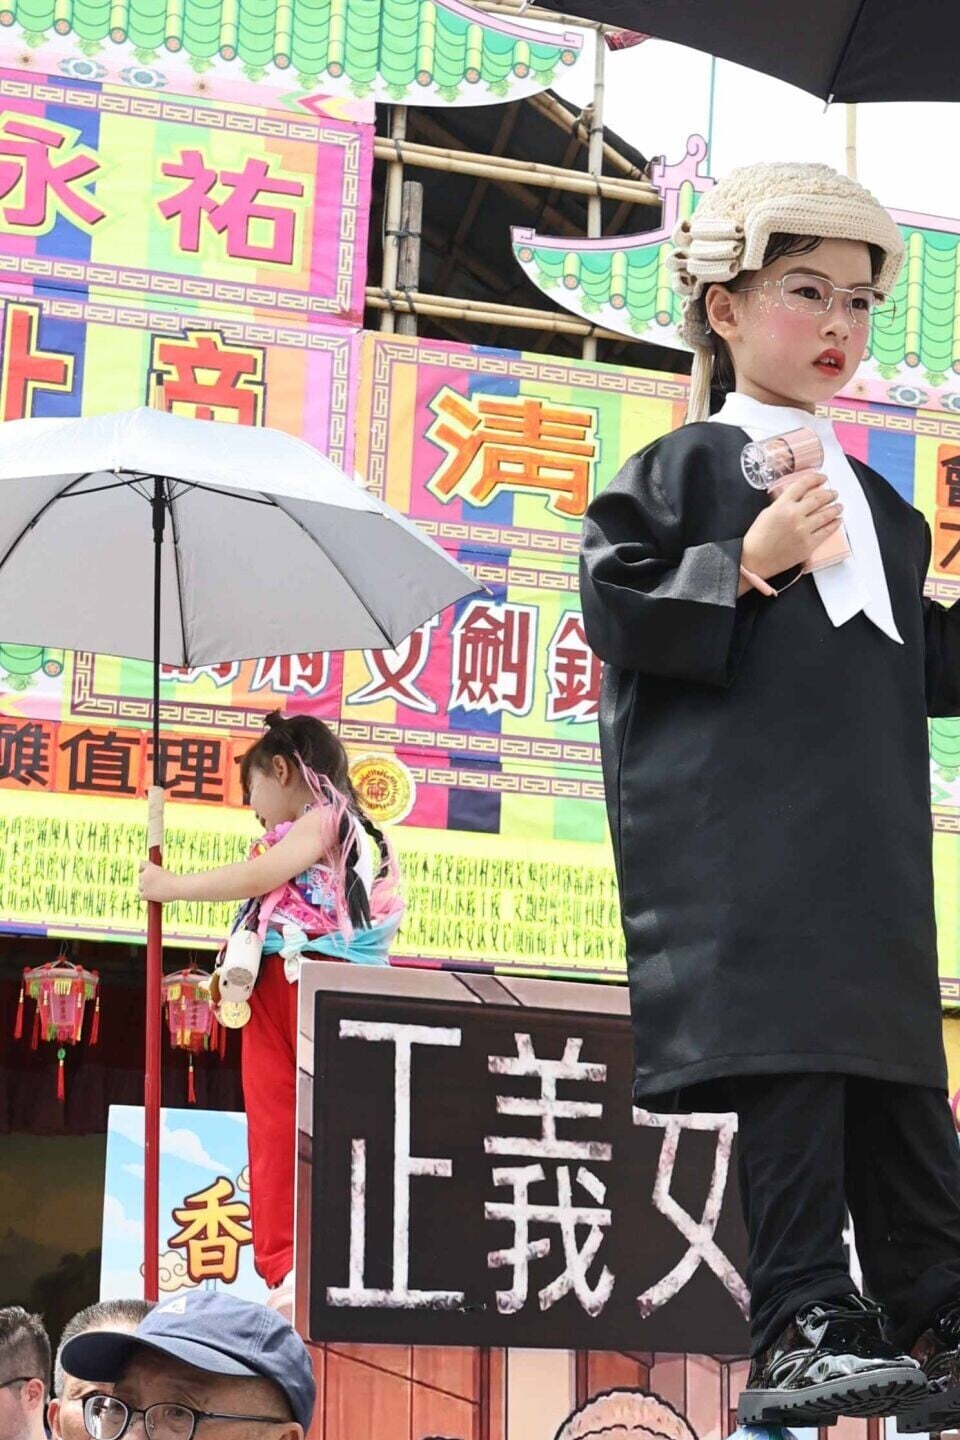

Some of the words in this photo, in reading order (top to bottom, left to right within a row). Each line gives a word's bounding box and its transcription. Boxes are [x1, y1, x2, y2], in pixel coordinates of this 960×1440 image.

[430, 384, 598, 515] 清
[0, 721, 250, 806] 醮值理
[169, 1177, 253, 1284] 香
